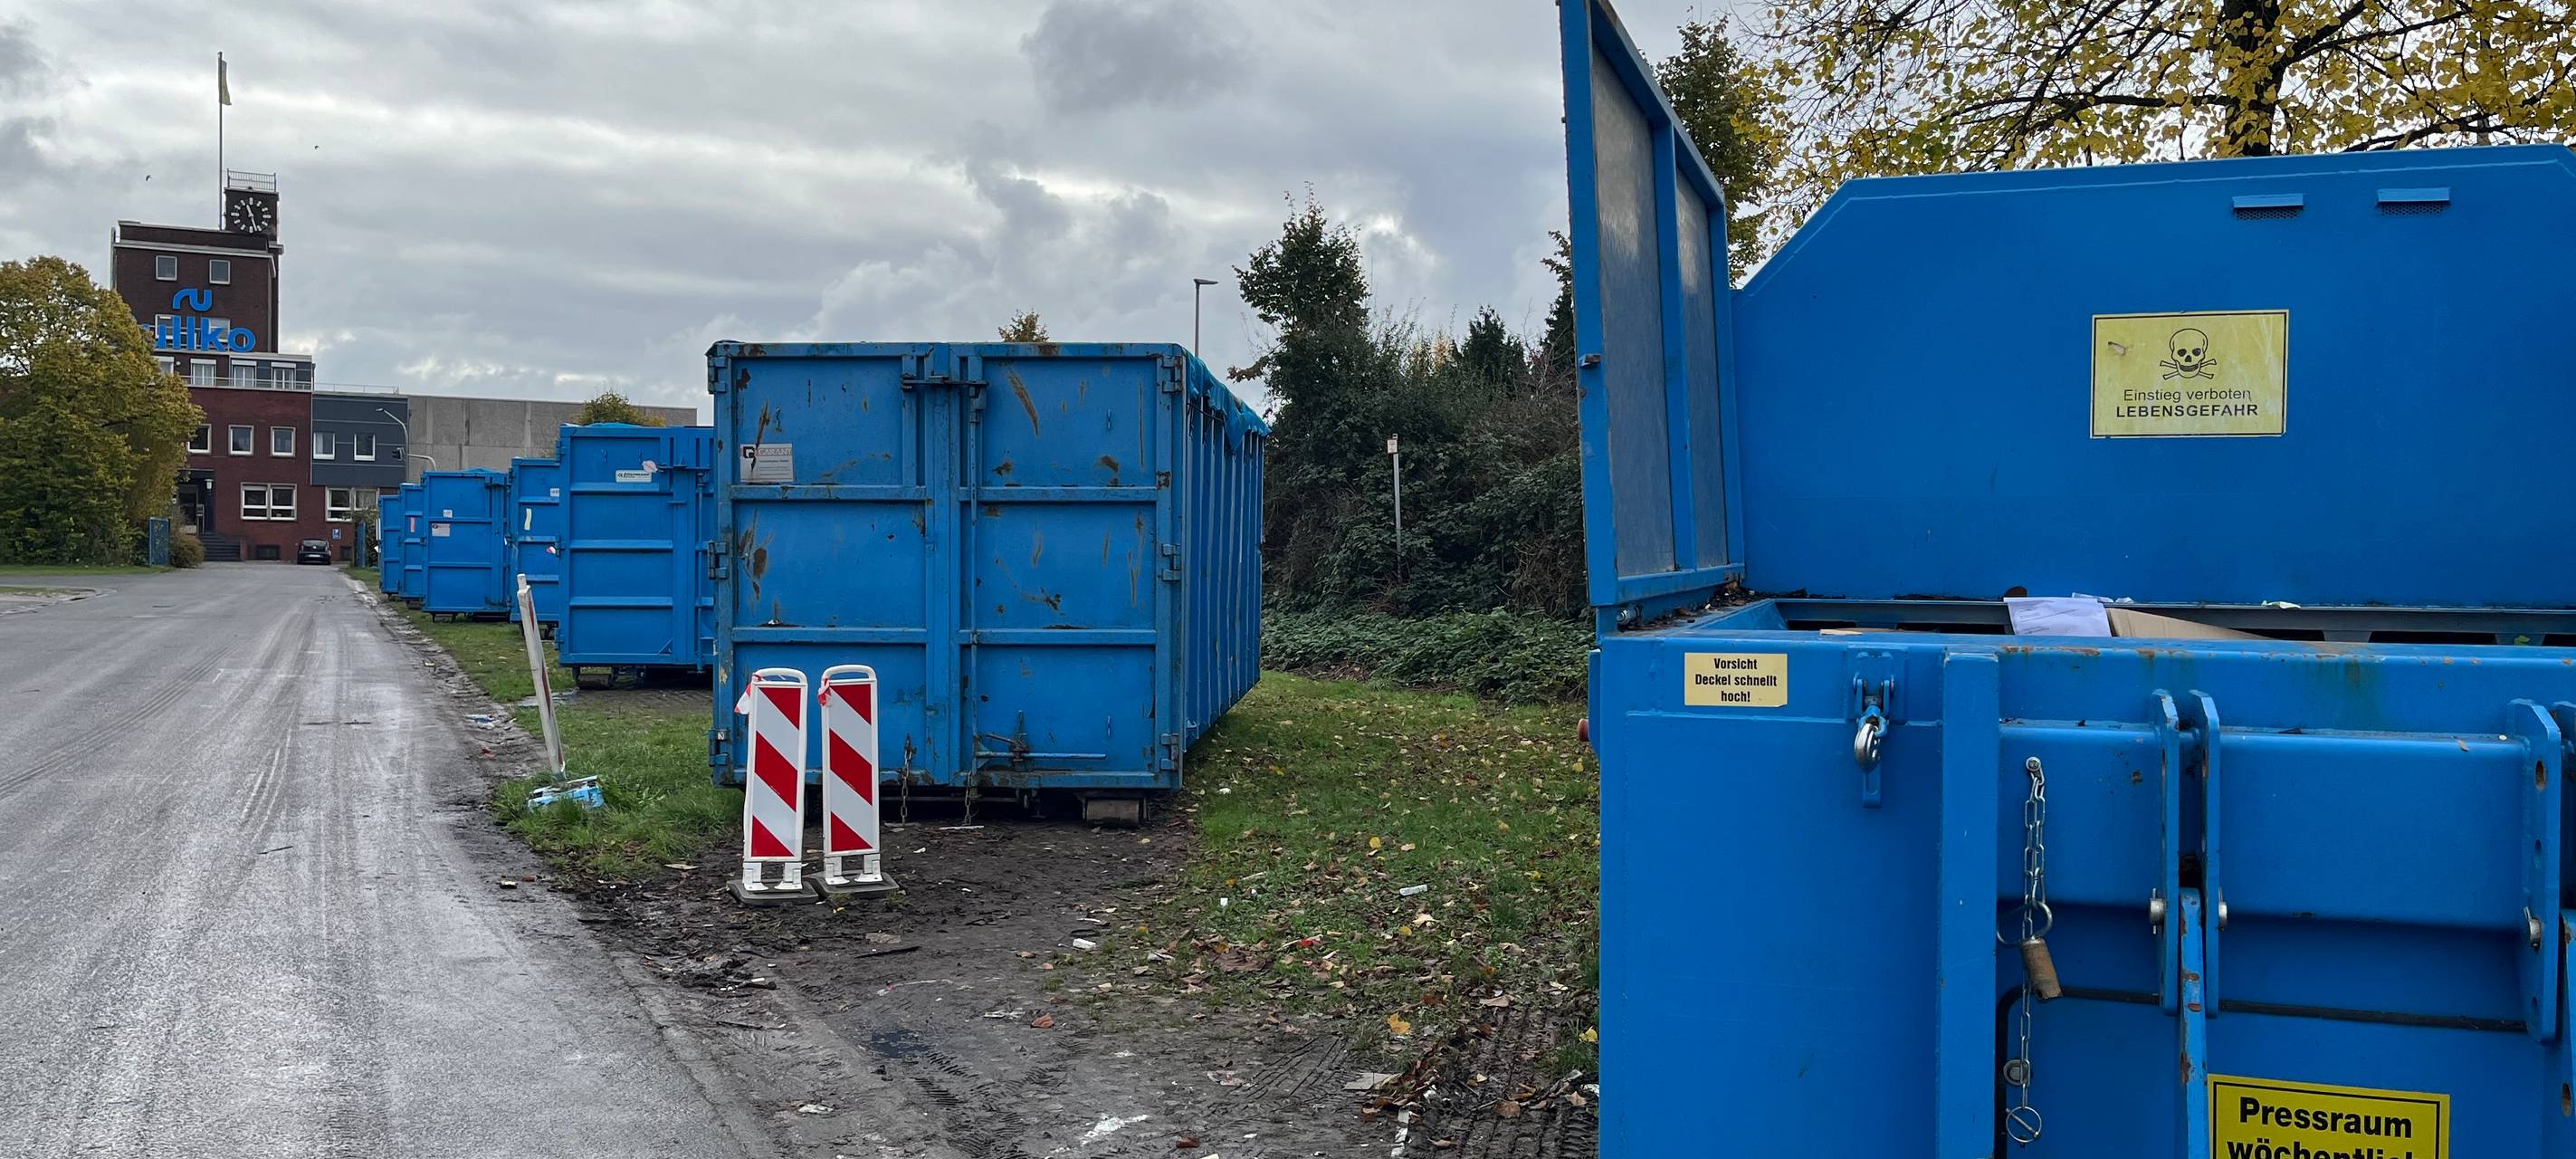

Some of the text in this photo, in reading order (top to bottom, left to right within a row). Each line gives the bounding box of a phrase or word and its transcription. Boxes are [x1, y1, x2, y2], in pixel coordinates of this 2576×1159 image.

[2123, 388, 2252, 401] Einstieg verboten
[2116, 404, 2258, 417] LEBENSGEFAHR
[1713, 657, 1758, 670] Vorsicht
[1694, 674, 1778, 686] Deckel schnellt
[1721, 691, 1751, 702] hoch!
[2239, 1096, 2412, 1139] Pressraum
